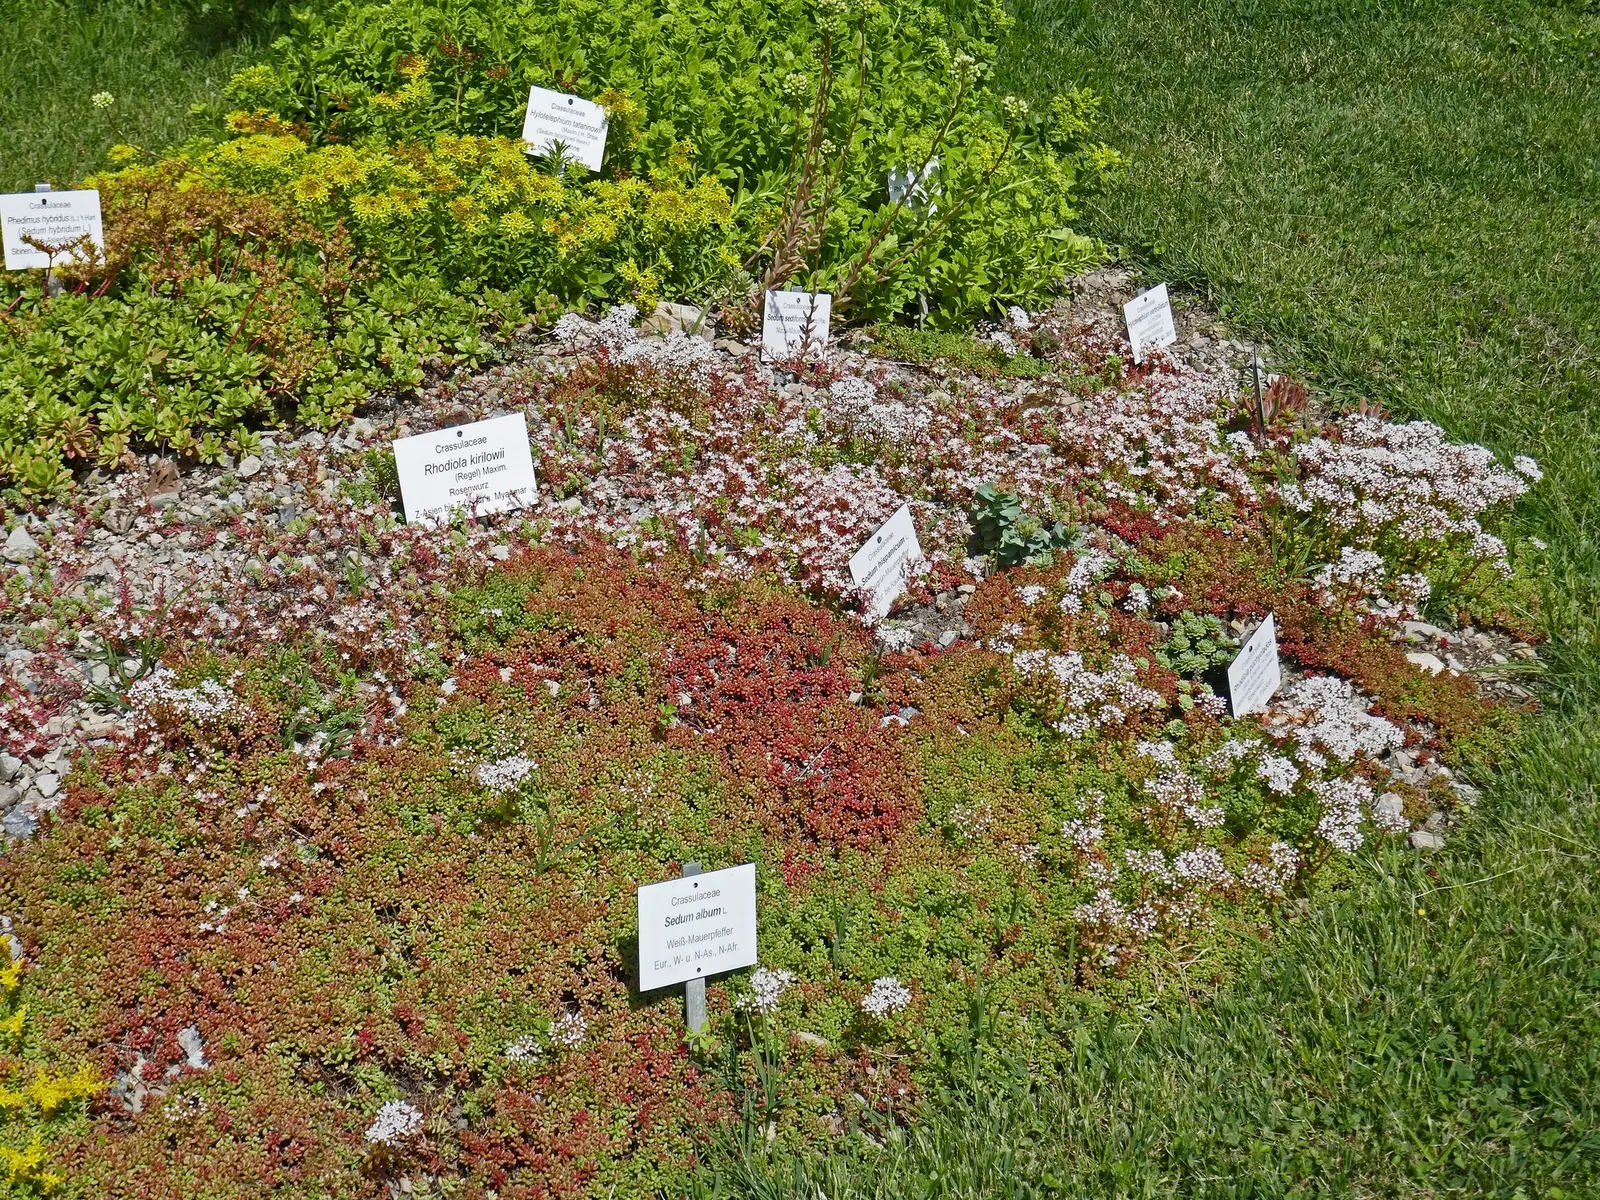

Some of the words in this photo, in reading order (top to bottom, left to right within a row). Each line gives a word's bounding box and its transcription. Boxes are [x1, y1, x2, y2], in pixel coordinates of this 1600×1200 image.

[7, 216, 41, 224] Phedimus
[42, 215, 70, 225] hybridus
[48, 225, 81, 235] hybridum
[435, 436, 487, 454] Crassulaceae
[424, 458, 467, 476] Rhodiola
[470, 448, 505, 465] kirilowii
[455, 469, 481, 483] (Regel)
[483, 464, 508, 475] Maxim.
[449, 482, 489, 497] Rosenwurz
[671, 889, 721, 907] Crassulaceae
[664, 913, 694, 928] Sedum
[695, 907, 722, 920] album
[666, 927, 734, 949] Weiß-Mauerpfeffer
[674, 956, 684, 966] W-
[719, 942, 740, 954] N-Afr.
